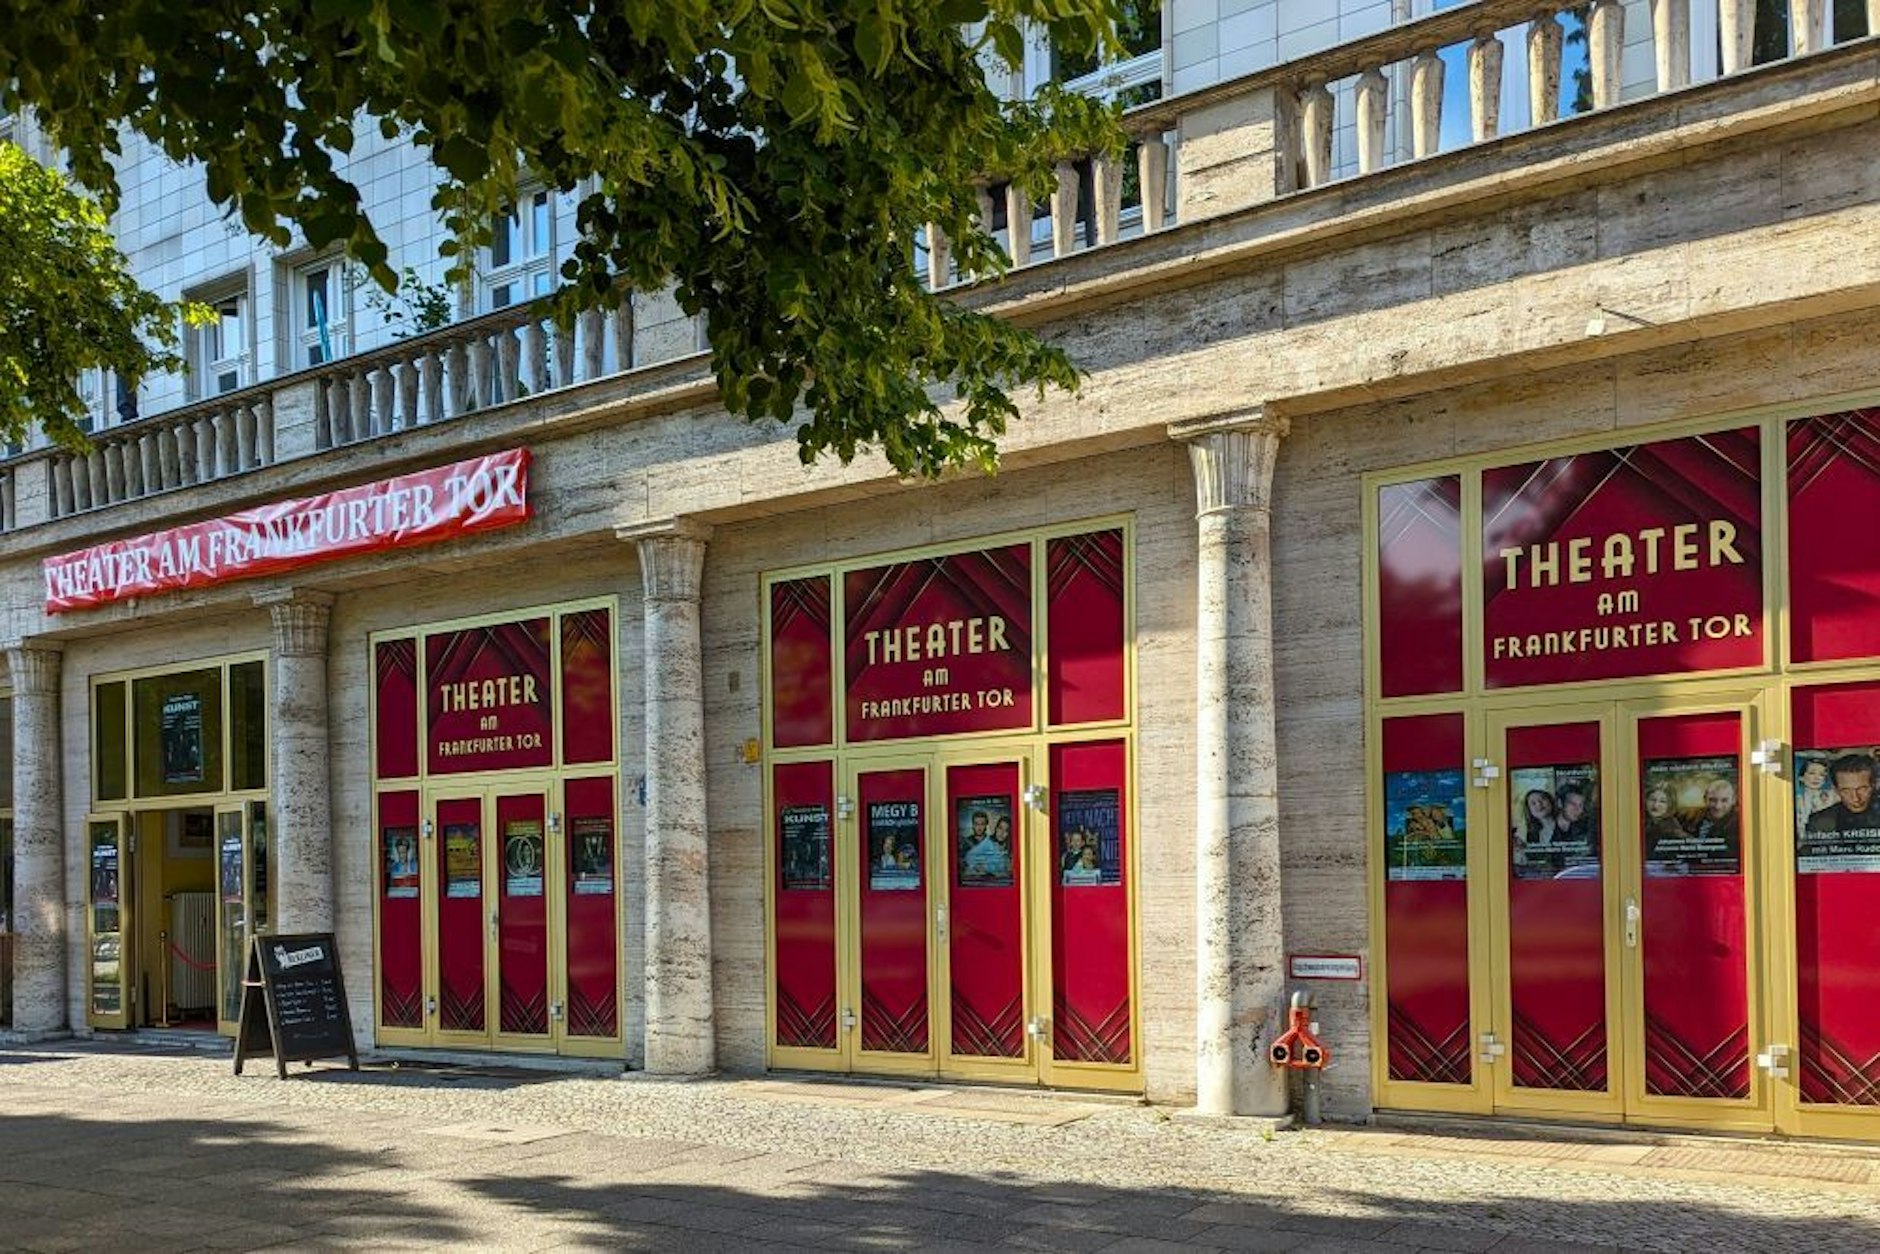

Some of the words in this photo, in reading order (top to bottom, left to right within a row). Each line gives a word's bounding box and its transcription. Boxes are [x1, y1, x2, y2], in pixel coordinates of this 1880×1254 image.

[45, 546, 153, 600] THEATER
[156, 536, 201, 578] AM
[207, 485, 436, 569] FRANKFURTER
[443, 465, 524, 520] TOR
[1499, 519, 1745, 590] THEATER
[1597, 590, 1640, 616] AM
[864, 615, 1011, 666] THEATER
[1493, 621, 1679, 660] FRANKFURTER
[1688, 613, 1753, 641] TOR
[440, 674, 539, 713] THEATER
[923, 668, 949, 687] AM
[861, 692, 972, 720] FRANKFURTER
[976, 688, 1015, 709] TOR
[480, 715, 499, 731] AM
[438, 736, 514, 757] FRANKFURTER
[517, 734, 543, 750] TOR
[784, 814, 829, 823] KUNST
